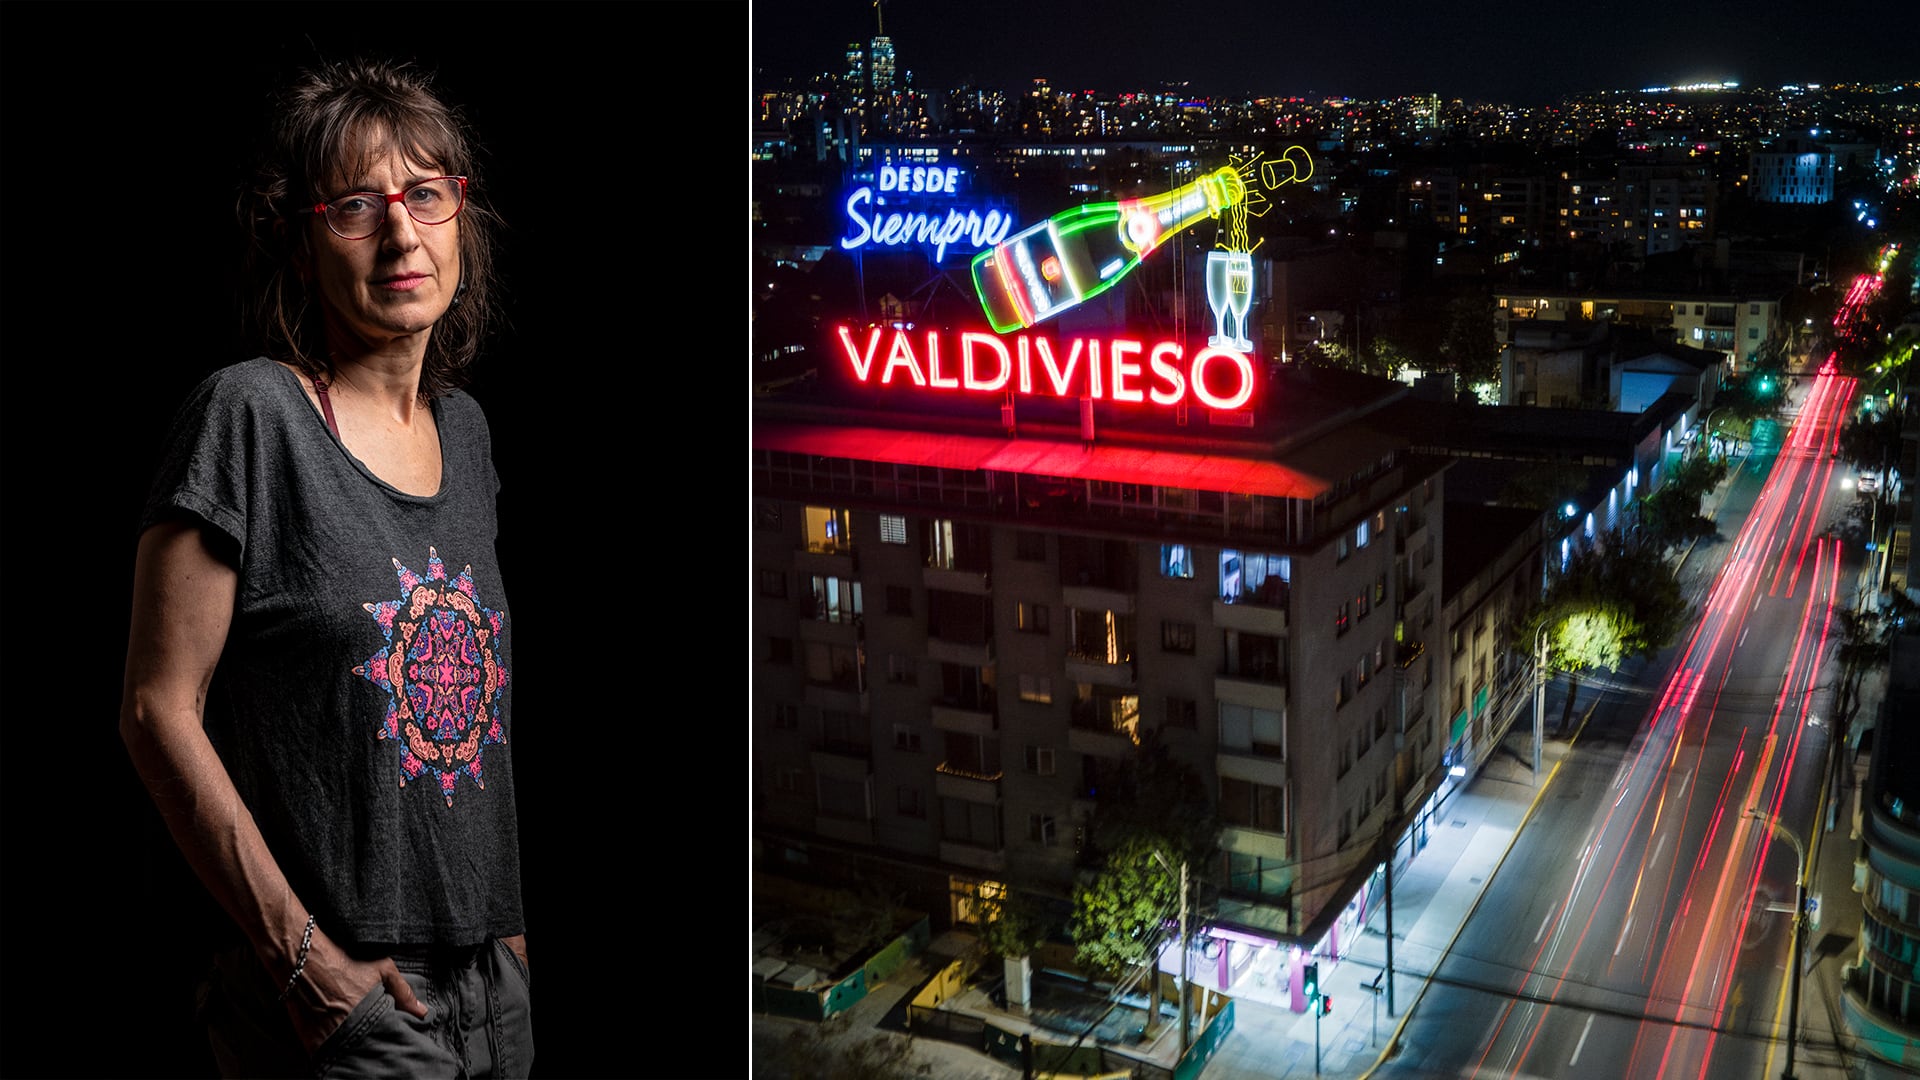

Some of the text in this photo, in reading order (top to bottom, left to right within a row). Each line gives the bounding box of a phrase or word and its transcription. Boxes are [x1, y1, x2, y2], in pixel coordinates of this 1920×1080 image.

[879, 165, 960, 193] DESDE
[841, 186, 1012, 263] Siempre
[838, 326, 1255, 410] VALDIVIESO
